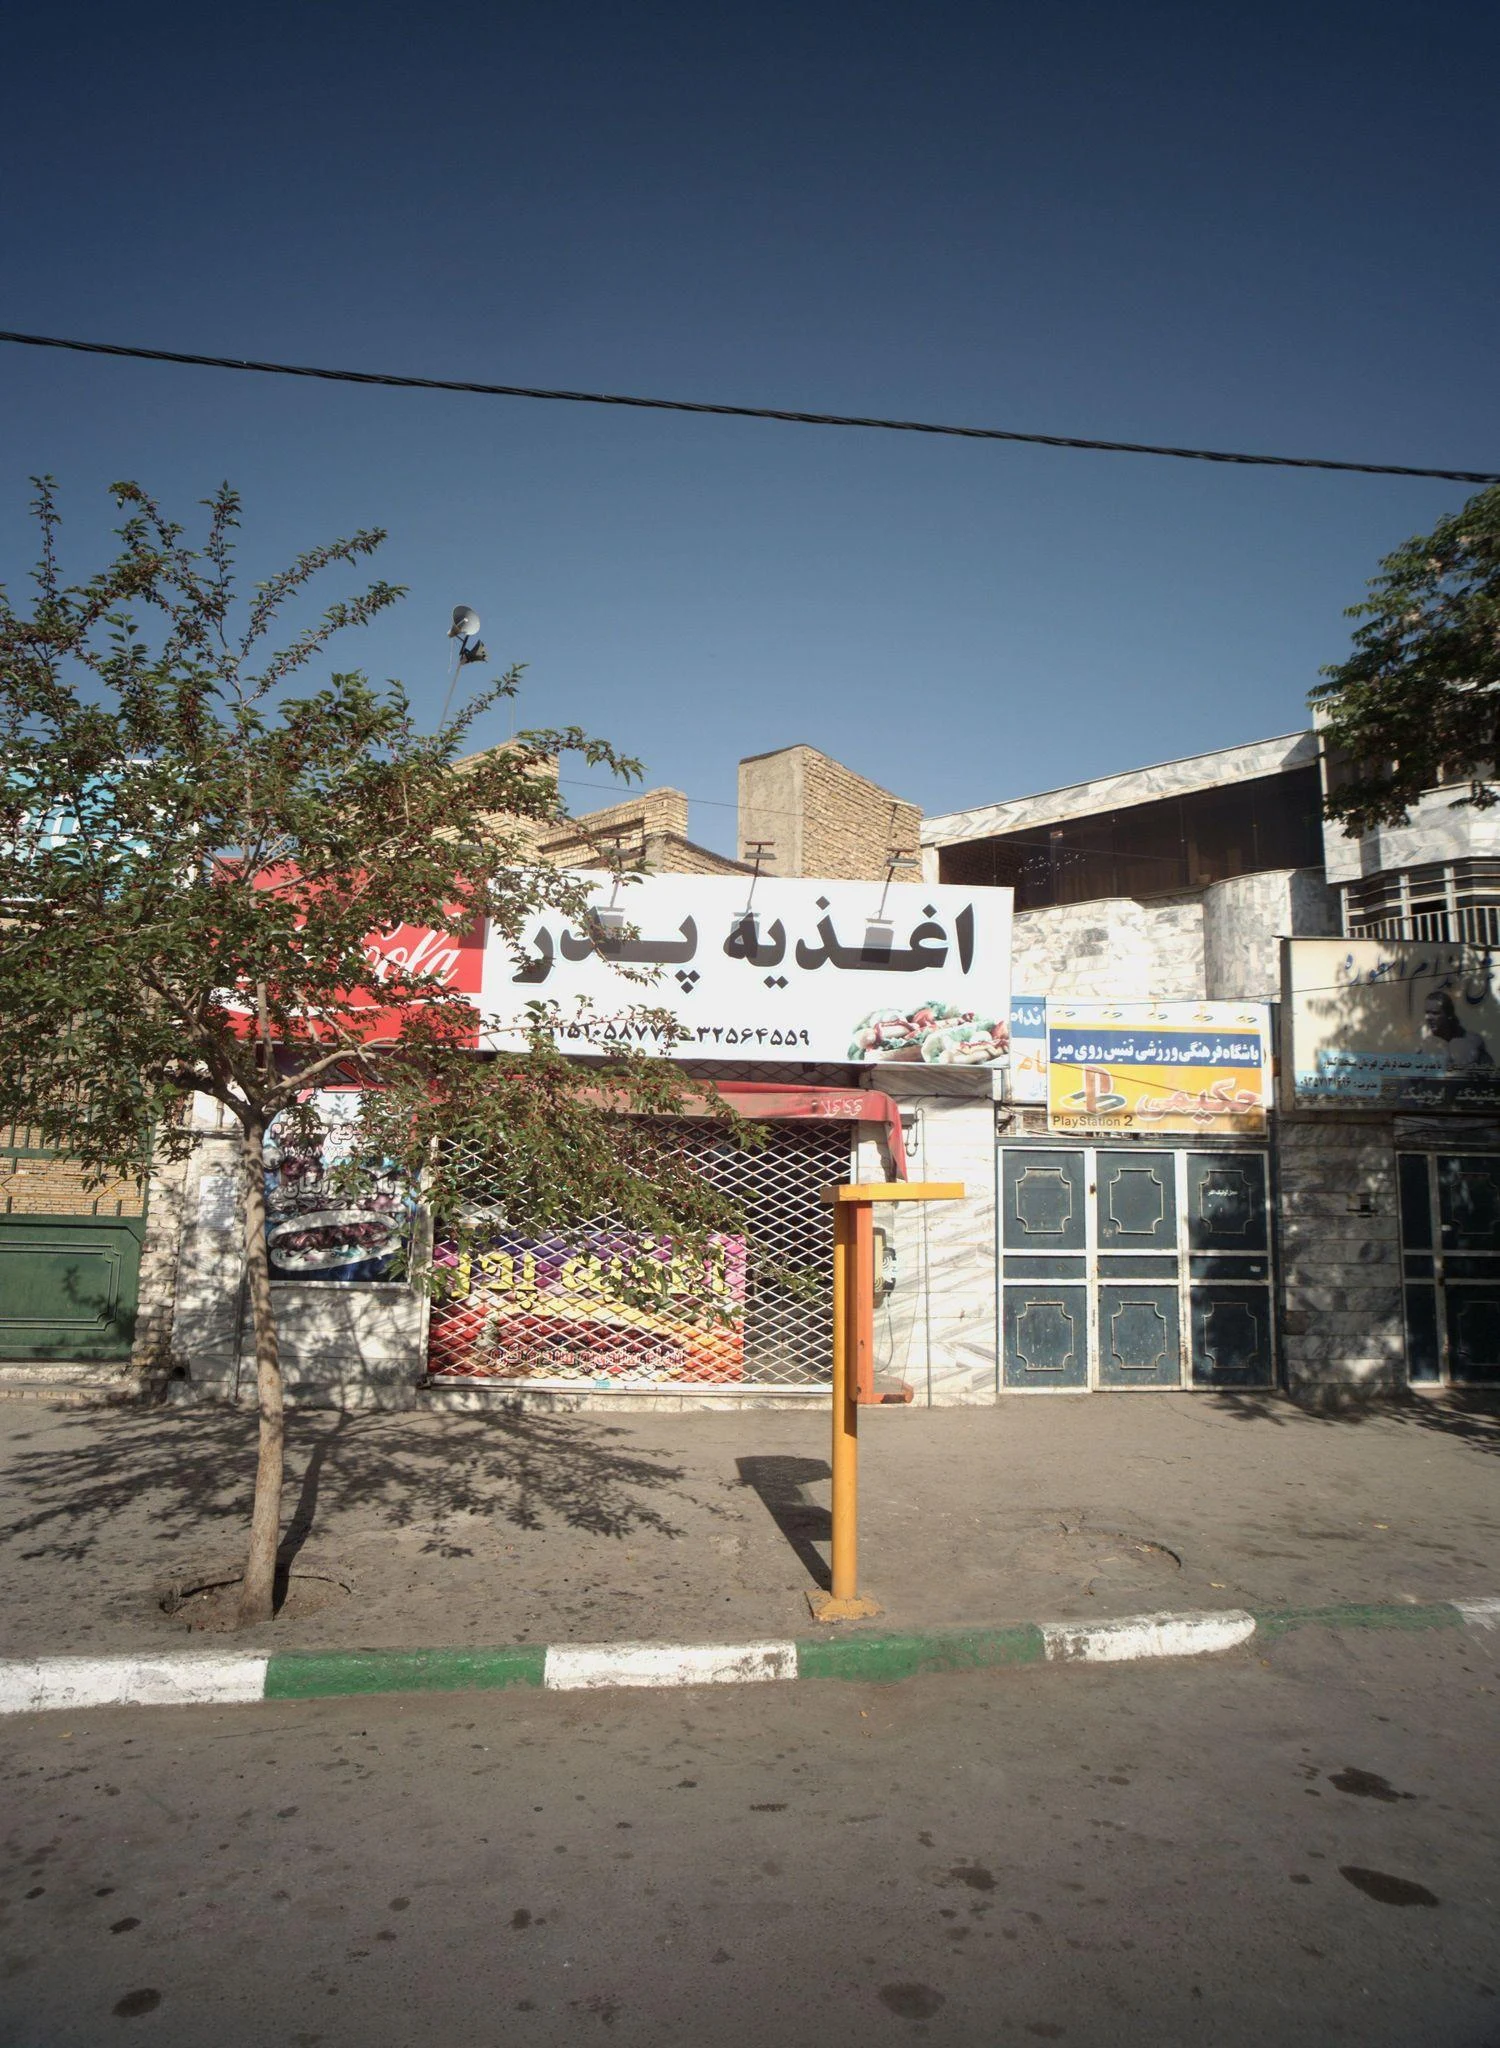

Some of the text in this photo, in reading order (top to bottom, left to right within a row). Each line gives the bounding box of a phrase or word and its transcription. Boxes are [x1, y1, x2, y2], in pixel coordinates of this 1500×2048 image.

[511, 896, 974, 994] اغذیه پدر
[1054, 1037, 1260, 1064] باشگاه فرهنگی ورزشی تنیس روی میز
[1135, 1077, 1264, 1125] حکیمی
[1052, 1114, 1134, 1128] PlayStation 2
